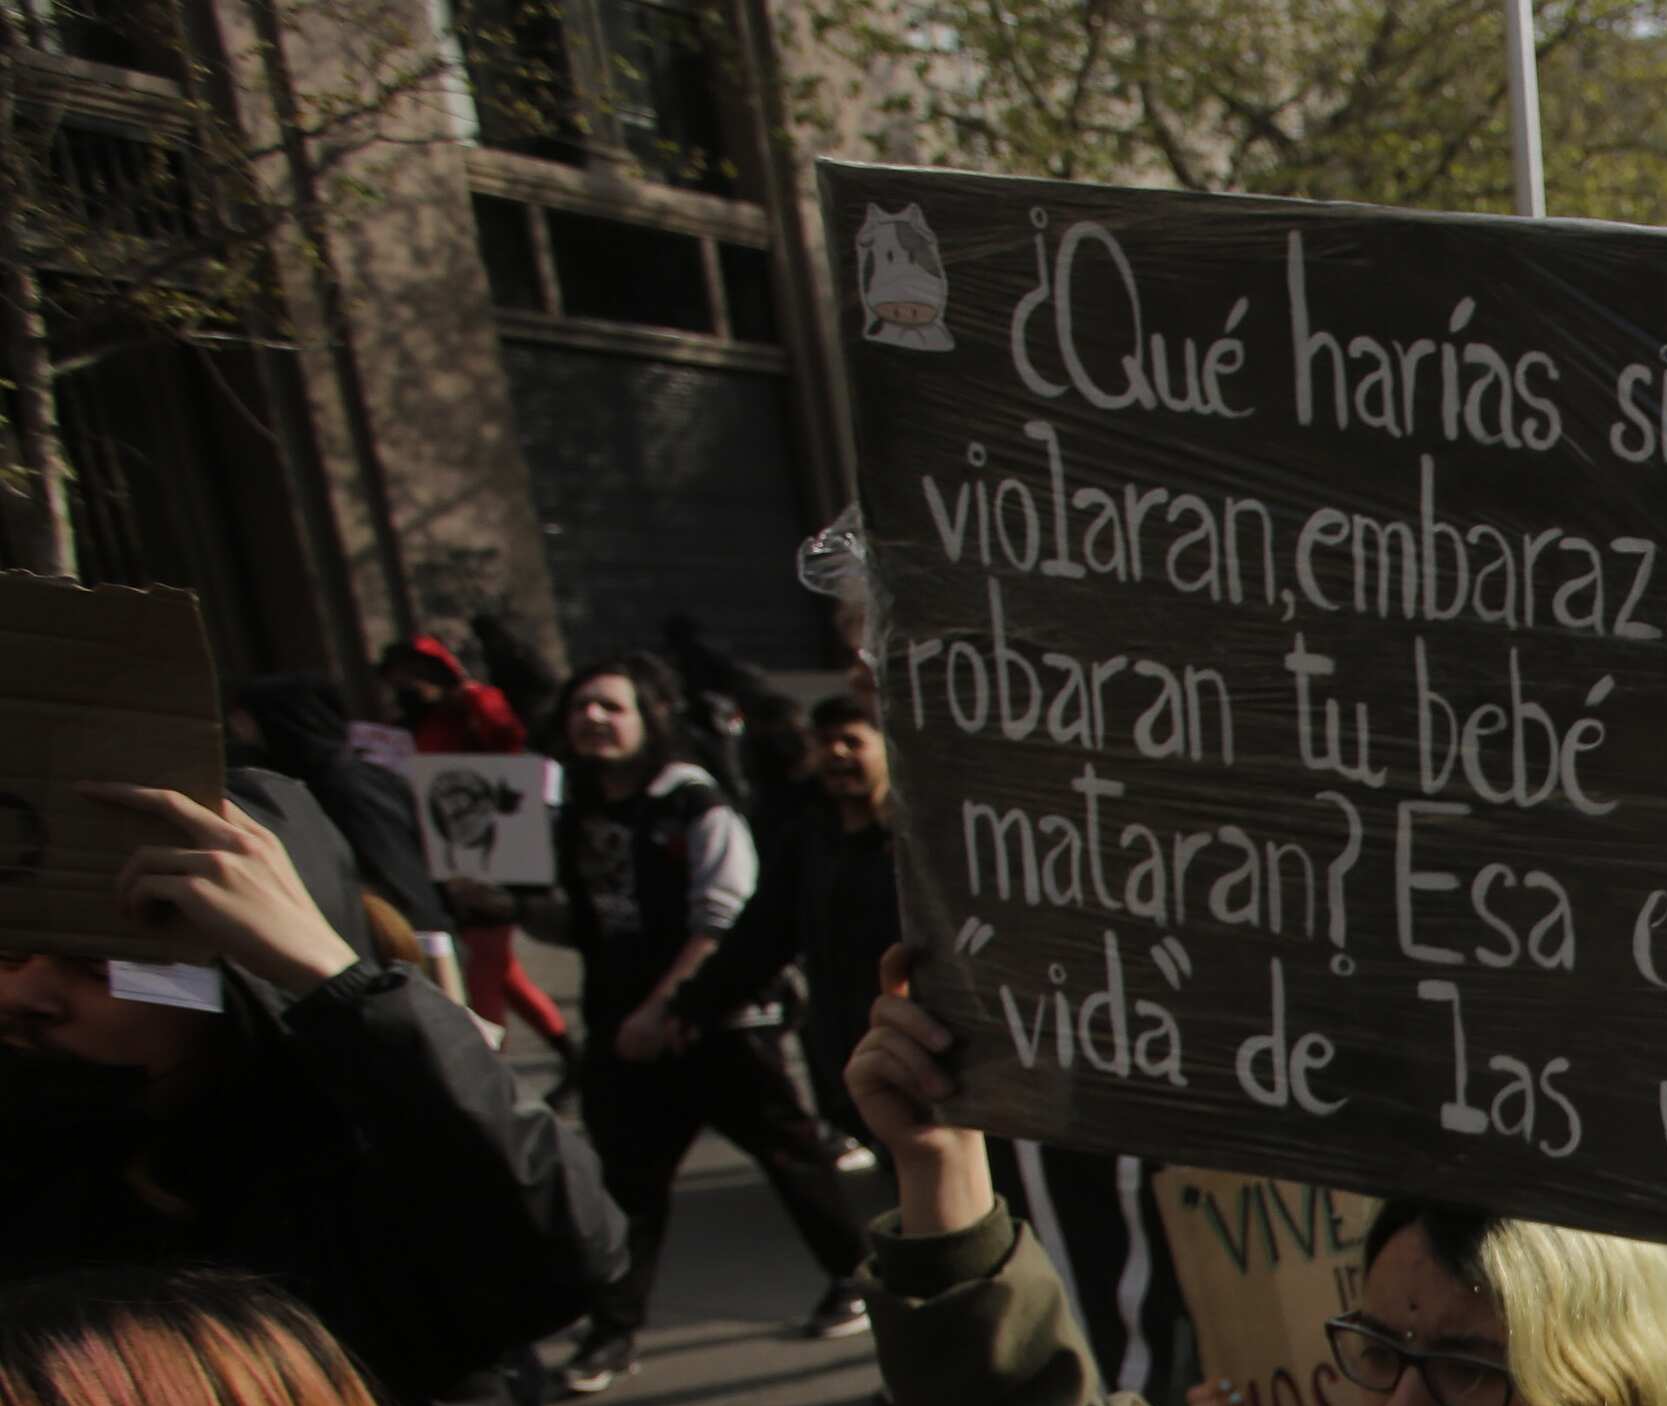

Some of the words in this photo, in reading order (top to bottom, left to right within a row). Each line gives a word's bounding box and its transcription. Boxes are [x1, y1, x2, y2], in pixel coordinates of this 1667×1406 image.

[1010, 206, 1256, 419] ¿Qué
[1288, 230, 1561, 453] harías
[908, 577, 1235, 767] robaran
[1284, 633, 1387, 788] tu
[1416, 637, 1618, 814] bebé
[963, 764, 1362, 976] mataran?
[1398, 802, 1576, 972] Esa
[1236, 960, 1349, 1116] de
[1418, 981, 1582, 1157] las
